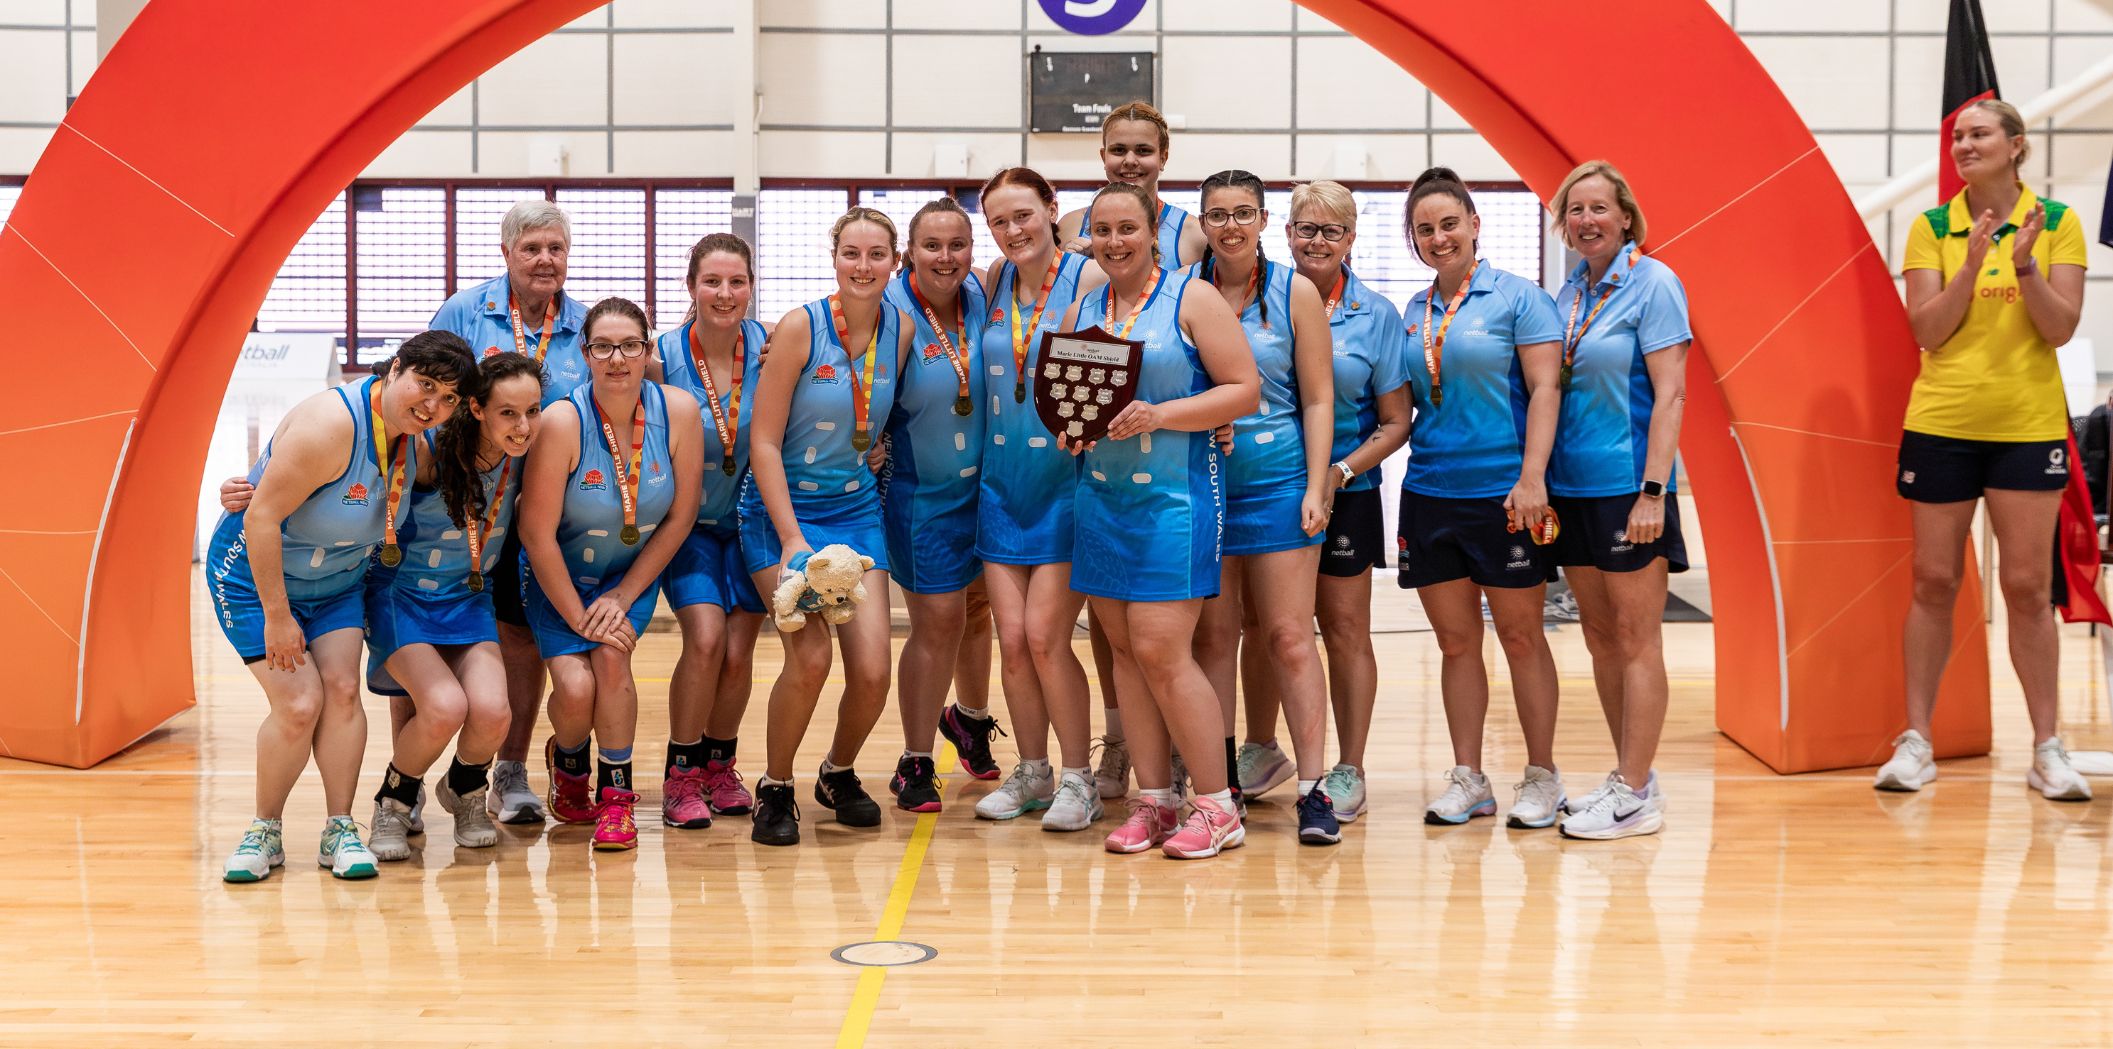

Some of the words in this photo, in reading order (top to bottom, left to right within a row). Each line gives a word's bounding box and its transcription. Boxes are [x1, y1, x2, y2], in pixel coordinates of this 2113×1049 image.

[1981, 286, 2020, 304] orig
[512, 309, 523, 337] SHIELD
[925, 307, 942, 334] SHIELD
[241, 344, 290, 360] tball
[939, 333, 956, 359] LITTLE
[698, 359, 713, 388] SHIELD
[952, 359, 967, 384] MARIE
[708, 389, 722, 416] LITTLE
[603, 423, 618, 453] SHIELD
[716, 418, 729, 444] MARIE
[614, 454, 626, 483] LITTLE
[1208, 453, 1220, 507] SOUTH
[620, 484, 632, 513] MARIE
[470, 529, 478, 557] MARIE
